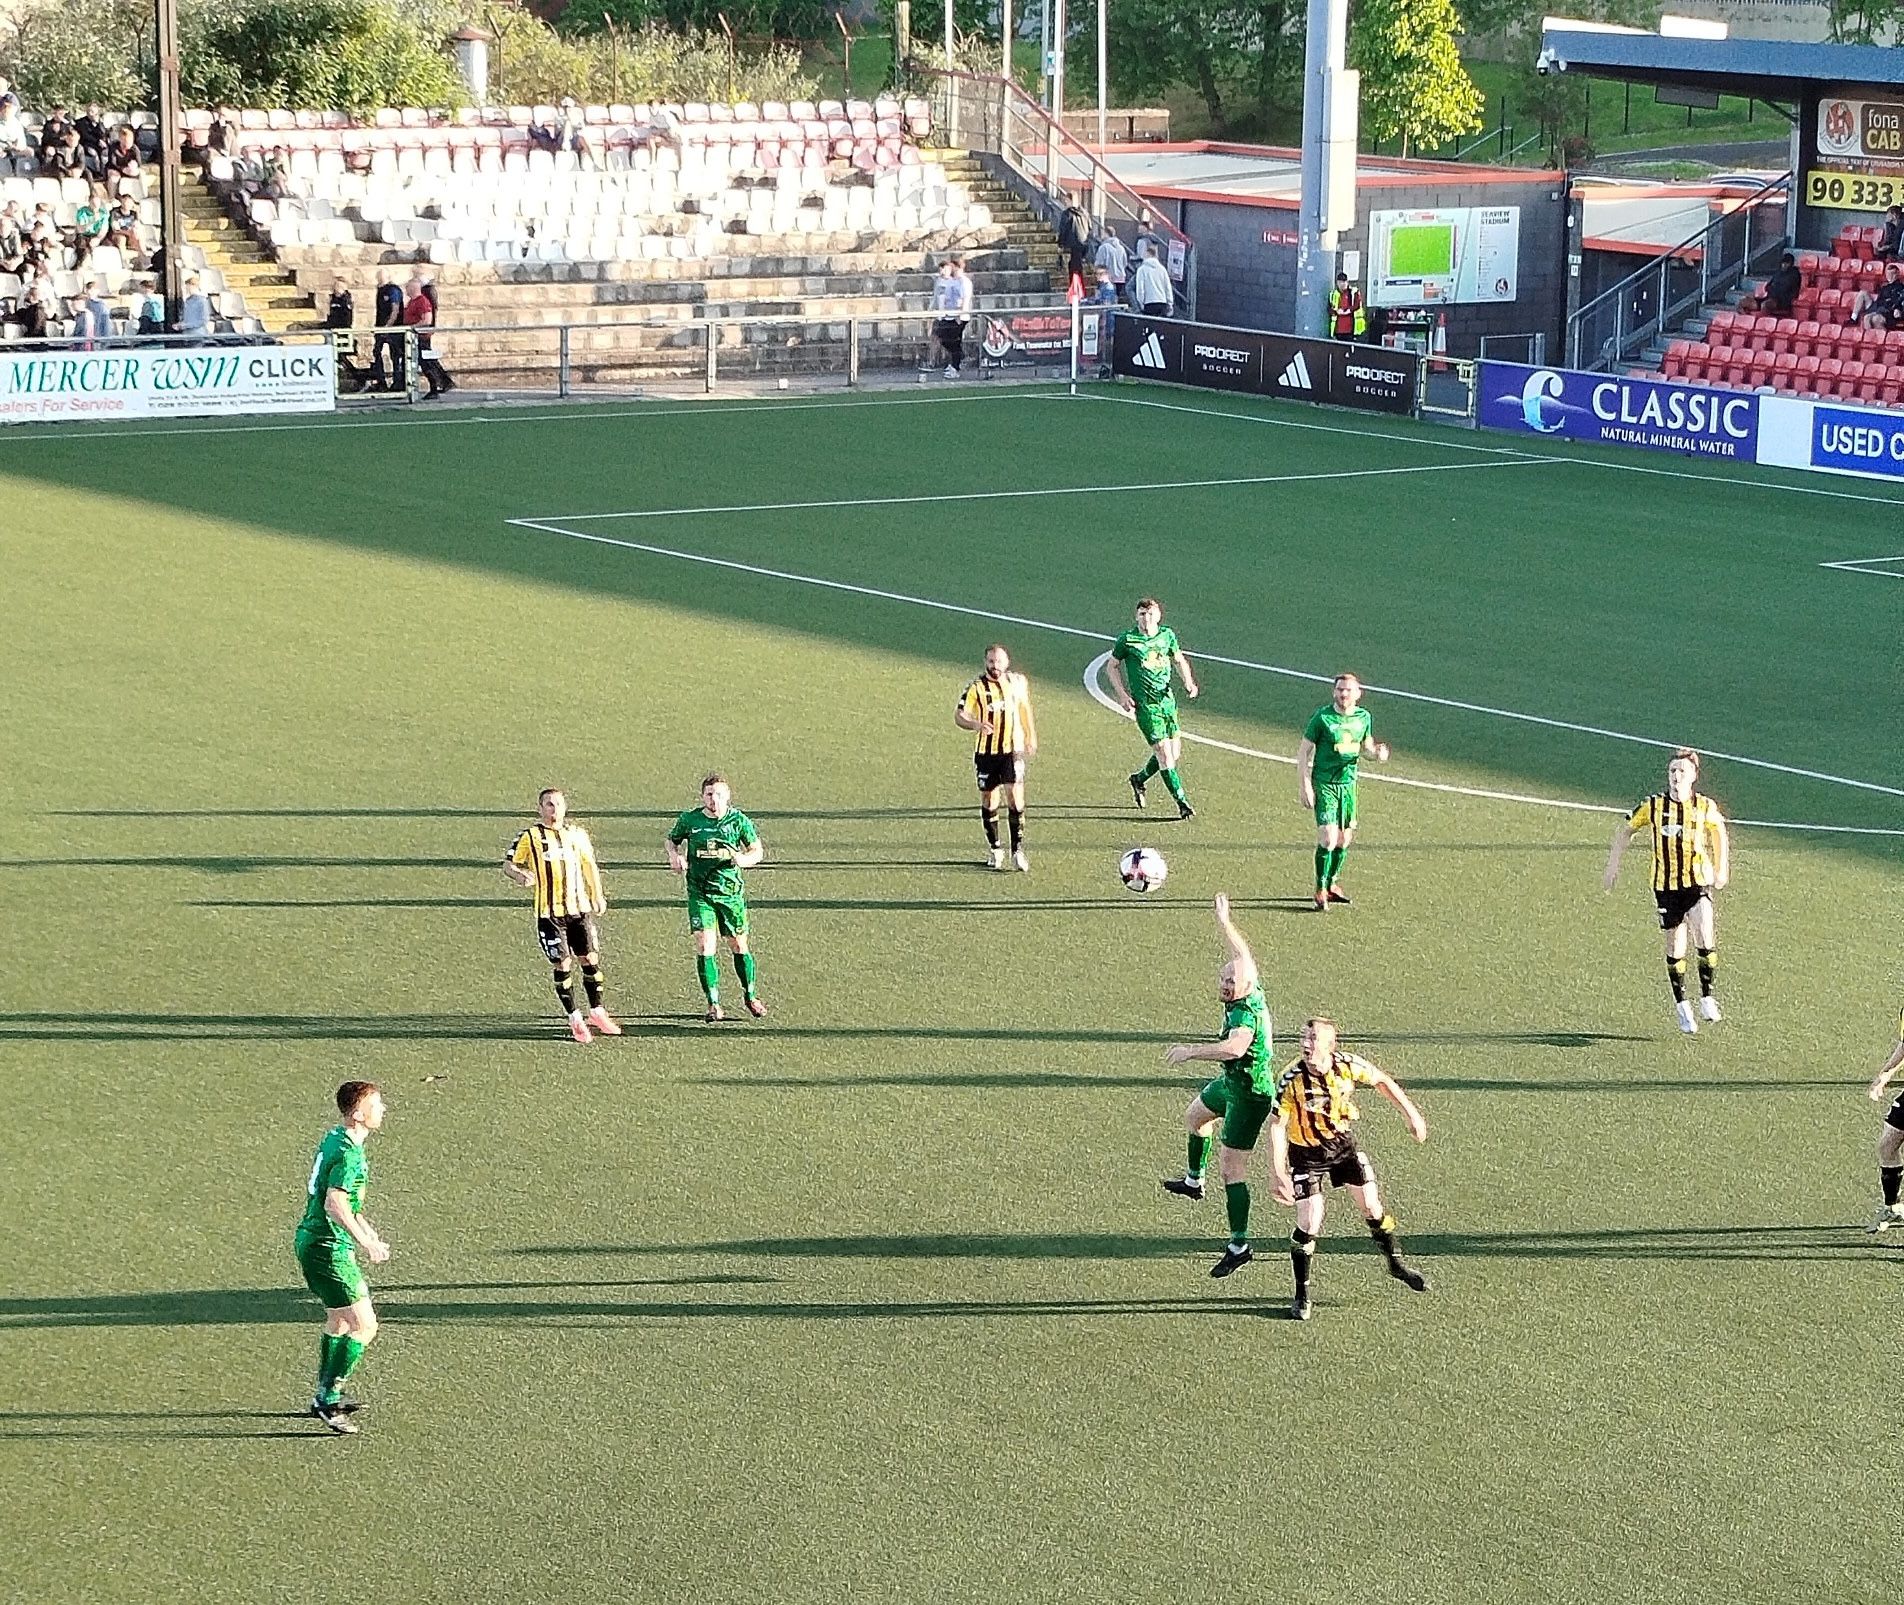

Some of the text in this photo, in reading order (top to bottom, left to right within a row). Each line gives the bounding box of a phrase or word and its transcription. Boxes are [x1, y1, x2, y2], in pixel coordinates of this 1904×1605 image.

[1868, 109, 1899, 129] fona
[1866, 129, 1901, 151] CAB
[1812, 177, 1845, 203] 90
[8, 358, 140, 394] MERCER
[249, 357, 325, 379] CLICK
[1202, 363, 1241, 375] SOCCER
[1355, 385, 1397, 398] SOCCER
[42, 399, 65, 414] For
[69, 397, 125, 411] Service
[1592, 382, 1750, 438] CLASSIC
[1600, 426, 1735, 457] NATURAL MINERAL WATER
[1821, 423, 1884, 458] USED
